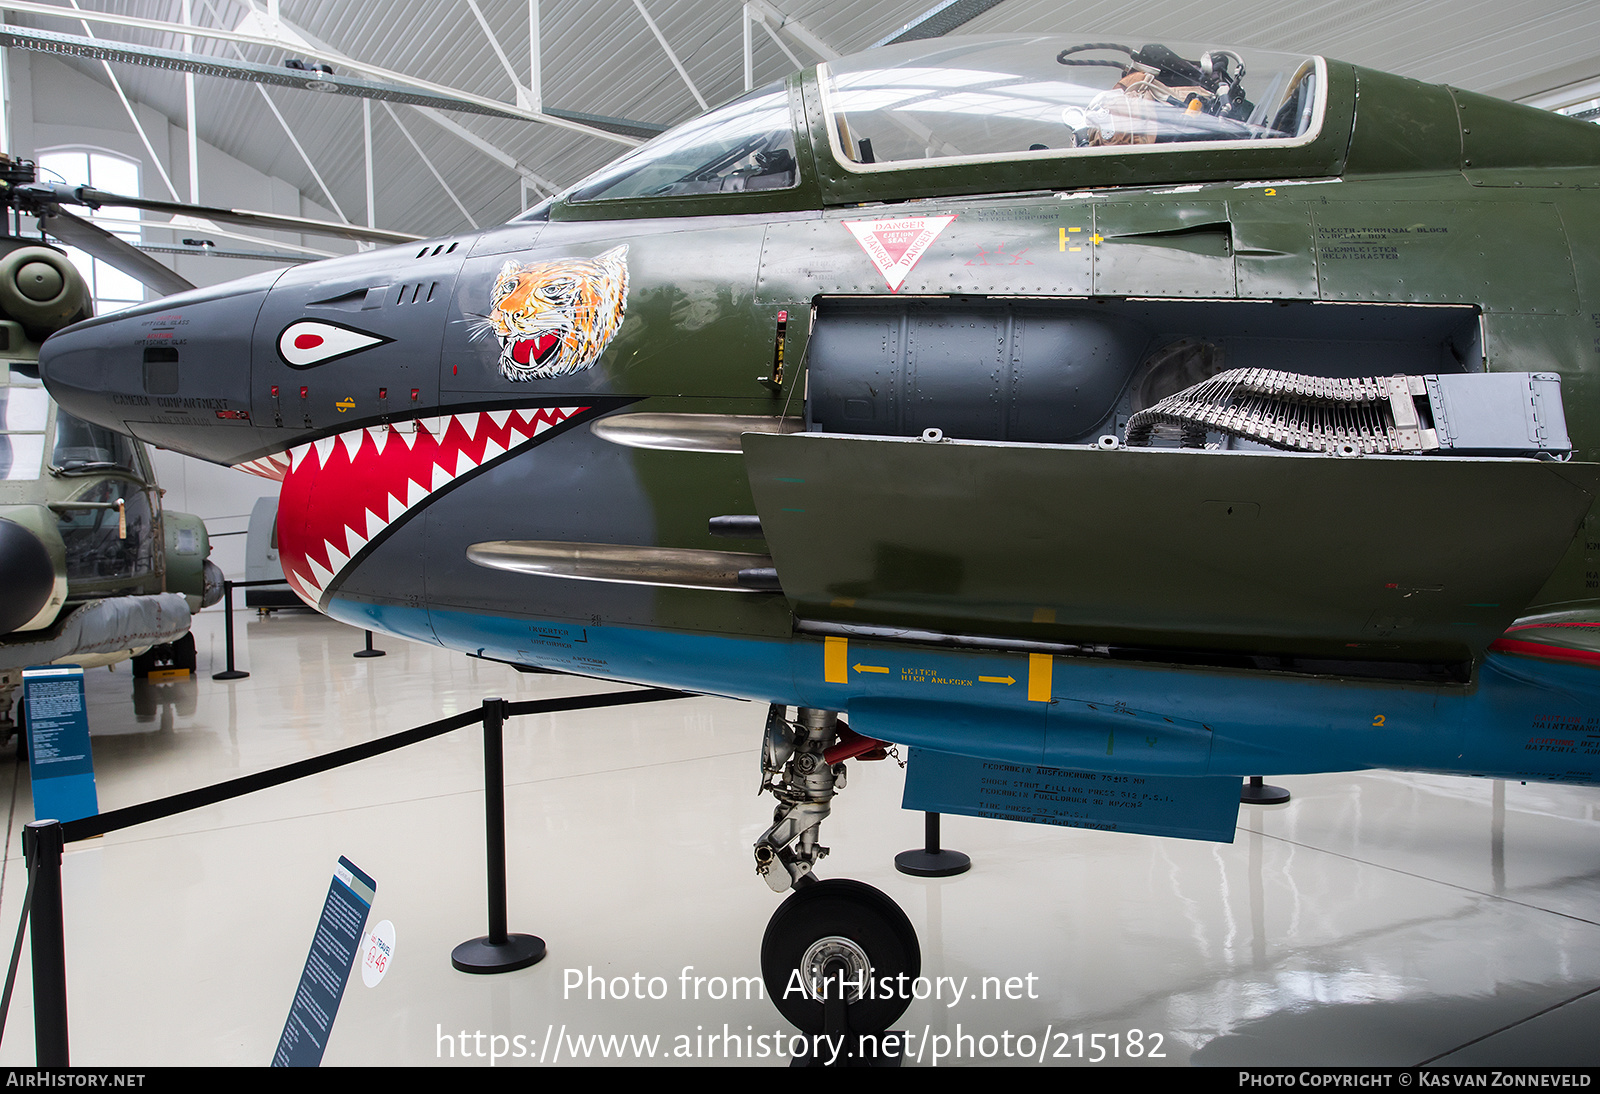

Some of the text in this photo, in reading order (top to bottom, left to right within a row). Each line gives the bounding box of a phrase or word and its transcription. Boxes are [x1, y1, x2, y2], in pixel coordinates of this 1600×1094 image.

[1264, 188, 1277, 196] 2
[875, 221, 925, 231] DANGER
[863, 234, 894, 270] DANGER
[900, 229, 935, 266] DANGER
[112, 394, 228, 410] CAMERA COMPARTMENT
[528, 625, 569, 636] INVERTER
[901, 667, 938, 677] LEITER
[901, 674, 973, 687] HIER ANLEGEN
[1372, 714, 1386, 727] 2
[1534, 714, 1581, 724] CAUTION
[1531, 721, 1600, 733] MAINTENANC
[1528, 737, 1575, 747] ACHTUNG
[1524, 744, 1578, 754] BATTERIE
[982, 763, 1032, 774] FEDERBEIN
[1036, 768, 1097, 780] AUSFEDERUNG
[981, 777, 1008, 786] SHOCK
[1013, 781, 1040, 789] STRUT
[1044, 784, 1083, 794] FILLING
[1088, 788, 1115, 797] PRESS
[980, 787, 1029, 798] FEDERBEIN
[1033, 793, 1087, 804] FUELLDRUCK
[979, 802, 1000, 810] TIRE
[1005, 805, 1032, 813] PRESS
[375, 953, 387, 973] 46
